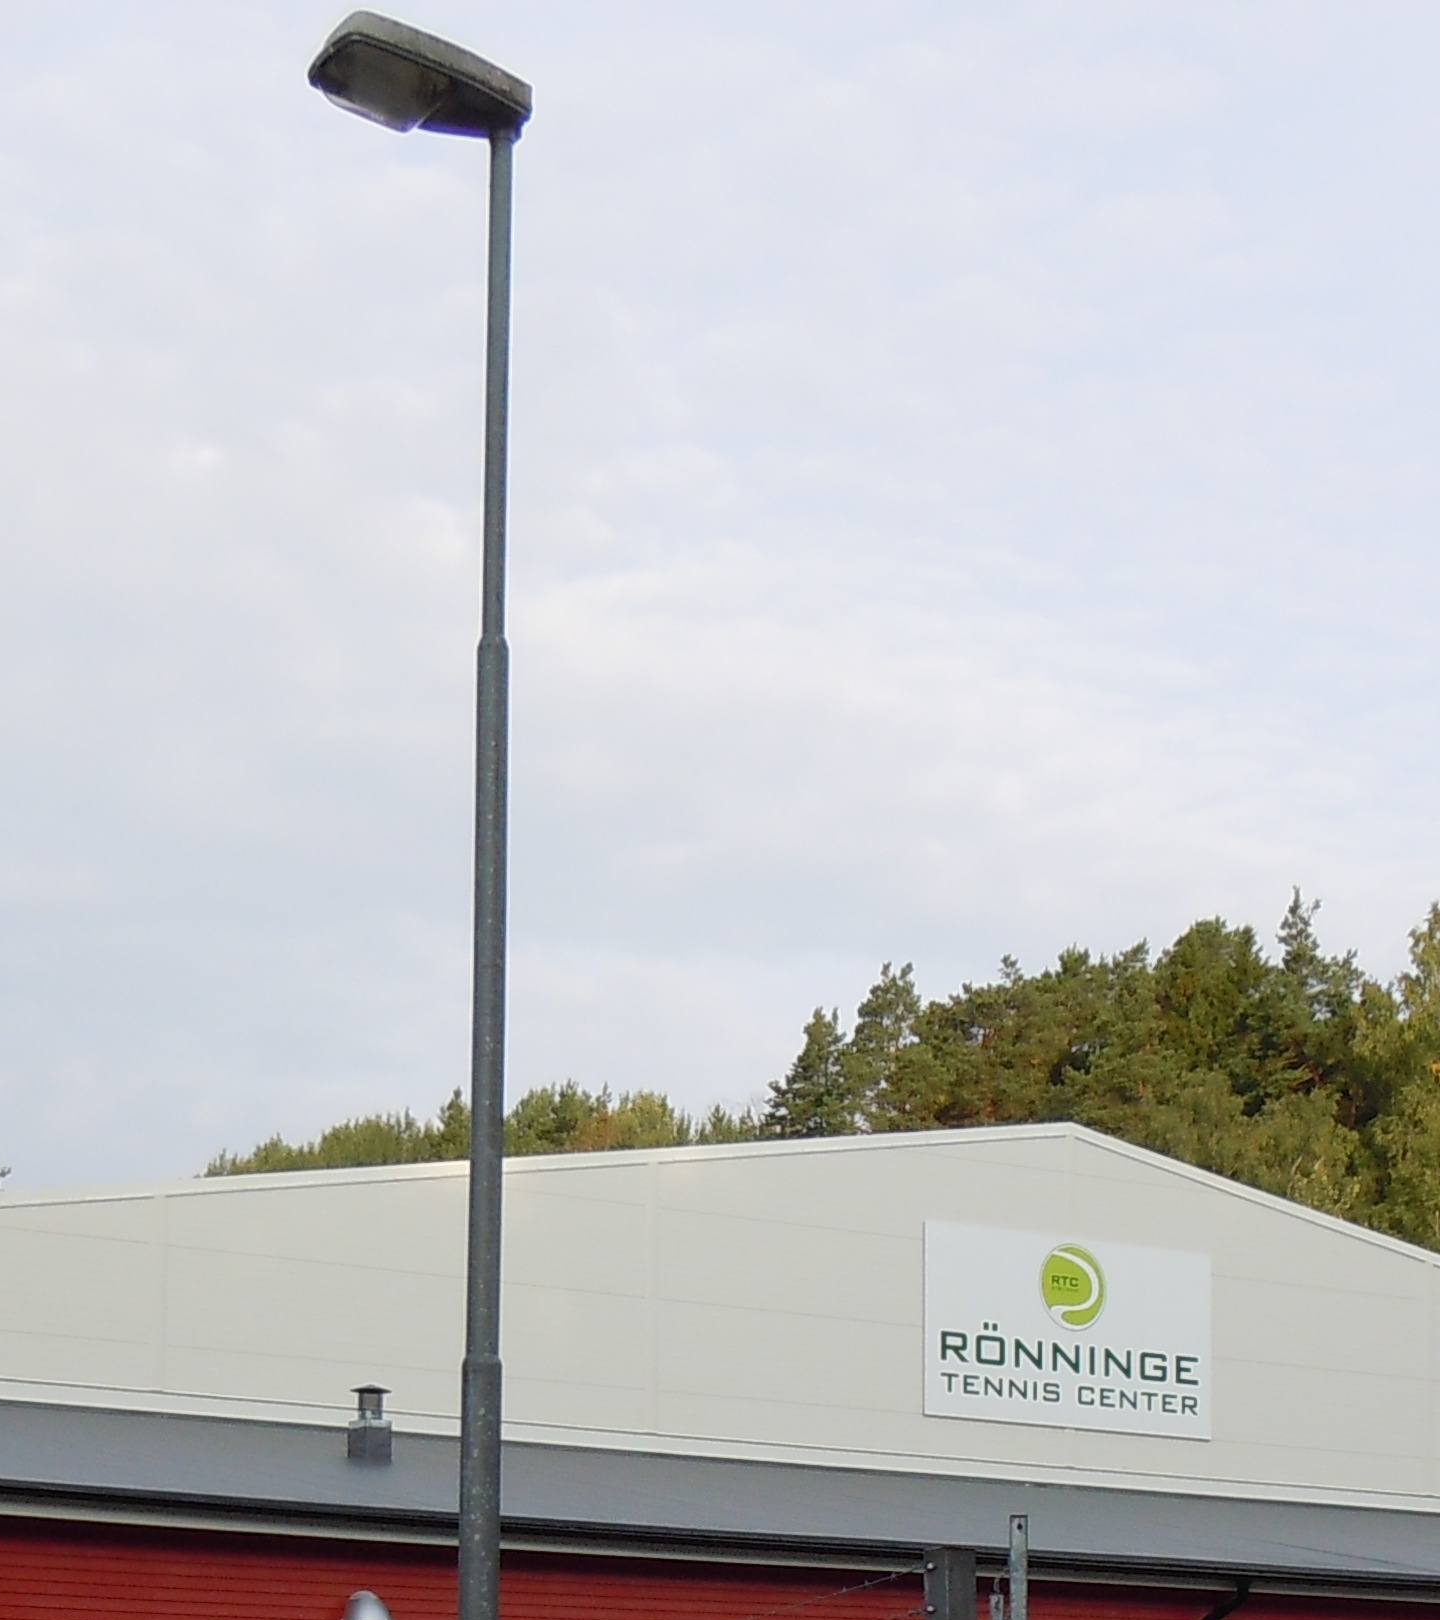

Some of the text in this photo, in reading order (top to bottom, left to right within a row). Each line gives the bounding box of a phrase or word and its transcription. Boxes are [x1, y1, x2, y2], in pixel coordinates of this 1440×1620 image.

[1051, 1274, 1079, 1288] RTC
[940, 1321, 1199, 1386] RÖNNINGE
[940, 1372, 1198, 1416] TENNIS CENTER
